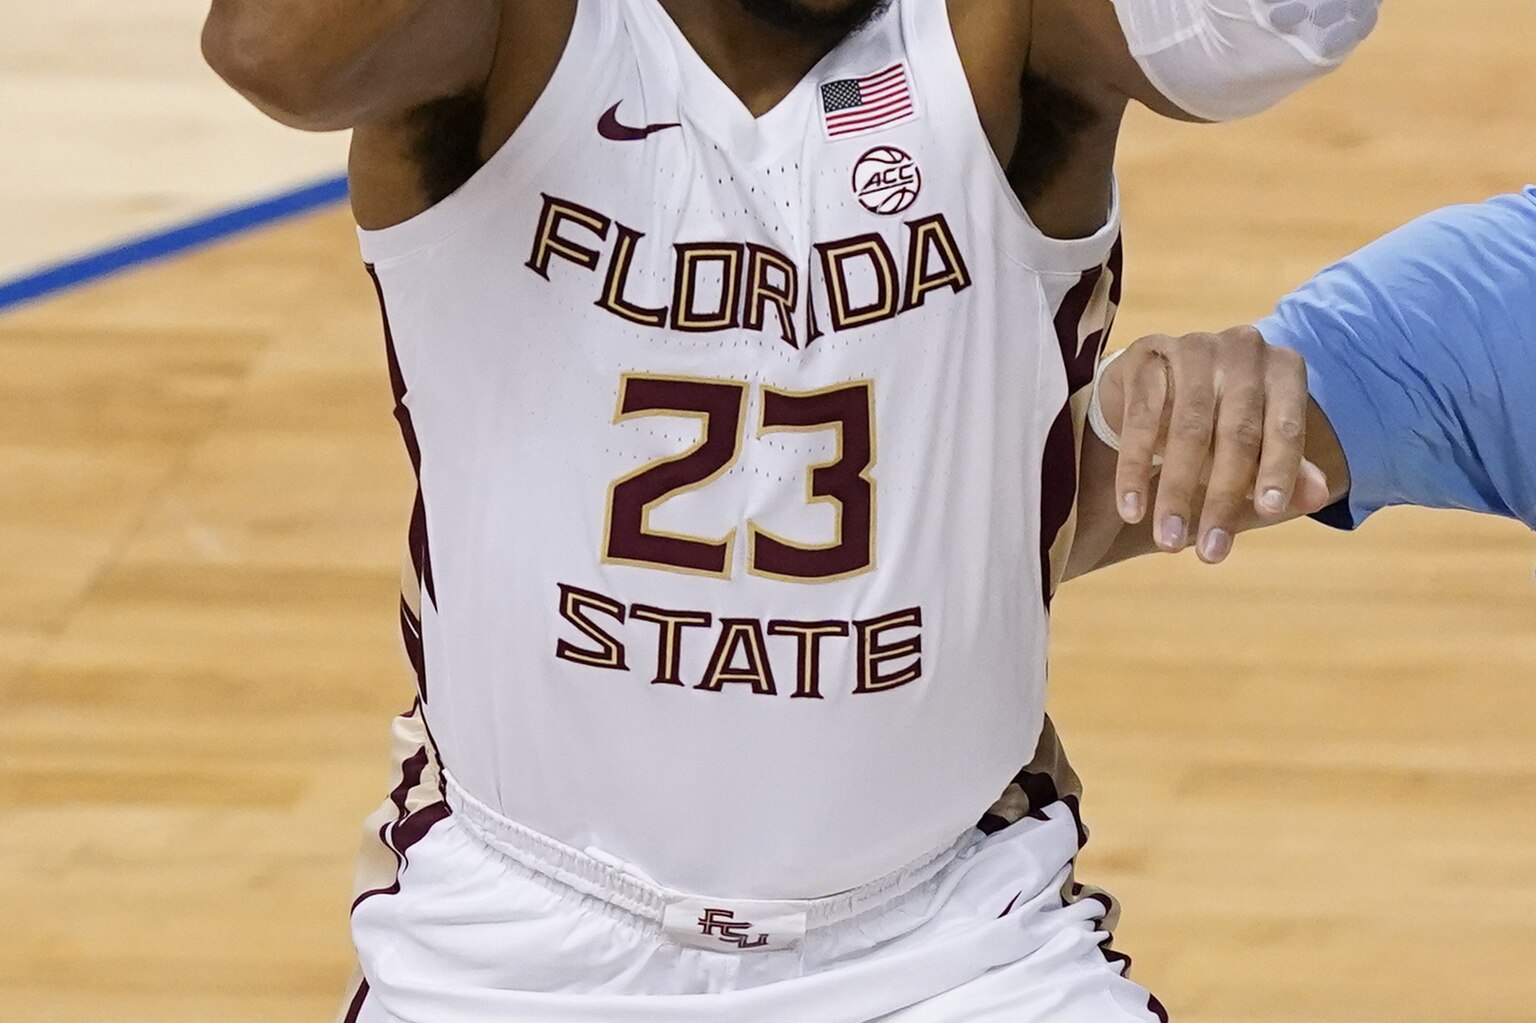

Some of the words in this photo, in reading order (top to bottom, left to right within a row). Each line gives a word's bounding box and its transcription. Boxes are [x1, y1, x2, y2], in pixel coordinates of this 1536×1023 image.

[861, 162, 915, 191] ACC
[600, 372, 877, 585] 23
[556, 582, 922, 699] STATE
